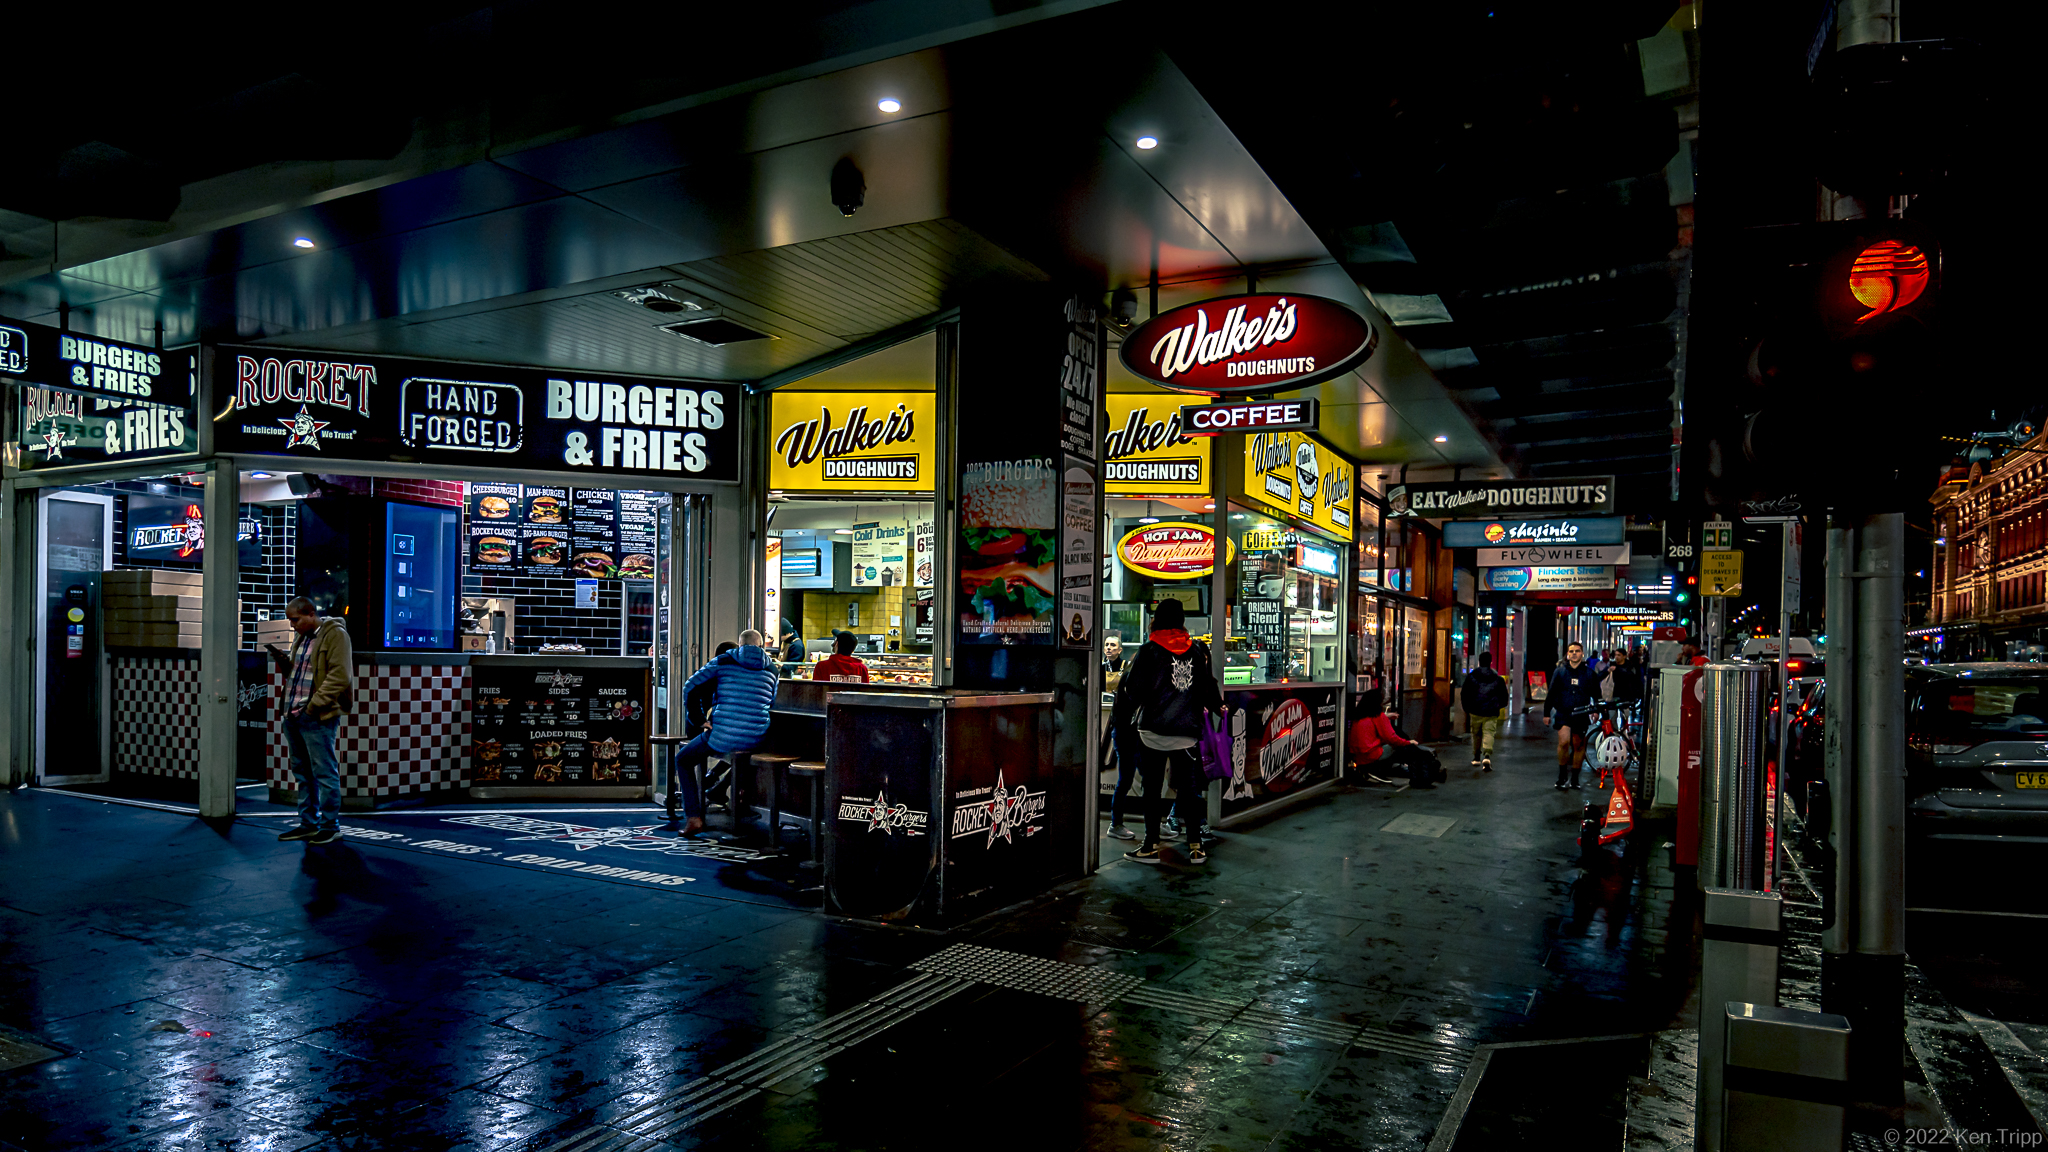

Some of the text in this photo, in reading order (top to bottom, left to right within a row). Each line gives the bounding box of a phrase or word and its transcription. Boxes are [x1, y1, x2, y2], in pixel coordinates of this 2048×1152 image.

[1068, 331, 1092, 366] OPEN
[1150, 298, 1297, 378] Walker's
[61, 336, 161, 376] BURGERS
[1063, 354, 1095, 401] 24/7
[1227, 357, 1315, 378] DOUGHNUTS
[72, 365, 152, 396] & FRIES
[236, 355, 377, 418] ROCKET
[427, 384, 497, 416] HAND
[547, 379, 725, 430] BURGERS
[1193, 404, 1300, 428] COFFEE
[105, 407, 184, 455] & FRIES
[252, 426, 287, 435] Delicious
[410, 414, 511, 448] FORGED
[775, 403, 915, 468] Walker's
[1063, 423, 1091, 441] DOUGHNUTS
[564, 428, 707, 473] & FRIES
[825, 461, 915, 478] DOUGHNUTS
[966, 458, 1053, 483] 100% BURGERS
[1105, 463, 1198, 480] DOUGHNUTS
[472, 485, 518, 497] CHEESEBURGER
[526, 488, 566, 499] MAN-BURGER
[576, 490, 615, 501] CHICKEN
[1412, 484, 1608, 509] EAT Walker's DOUGHNUTS
[134, 528, 183, 546] ROCKET
[472, 528, 517, 538] ROCKET CLASSIC
[620, 523, 645, 532] VEGAN
[854, 526, 905, 541] Cold Drinks
[1142, 531, 1203, 543] HOT JAM
[917, 537, 925, 552] 6
[1130, 538, 1215, 569] Doughnuts
[1501, 549, 1602, 560] FLY WHEEL
[1668, 545, 1694, 558] 268
[1065, 553, 1079, 565] BLACK
[1538, 566, 1605, 576] Flinders Street
[1248, 602, 1281, 612] ORIGINAL
[479, 687, 501, 695] FRIES
[598, 688, 627, 696] SAUCES
[1270, 710, 1287, 739] HOT
[1286, 703, 1303, 725] JAM
[530, 731, 588, 741] LOADED FRIES
[839, 803, 927, 828] ROCKET Burgers
[952, 785, 1046, 836] ROCKET Burgers
[502, 852, 588, 870] COLD
[572, 864, 697, 887] DRINKS
